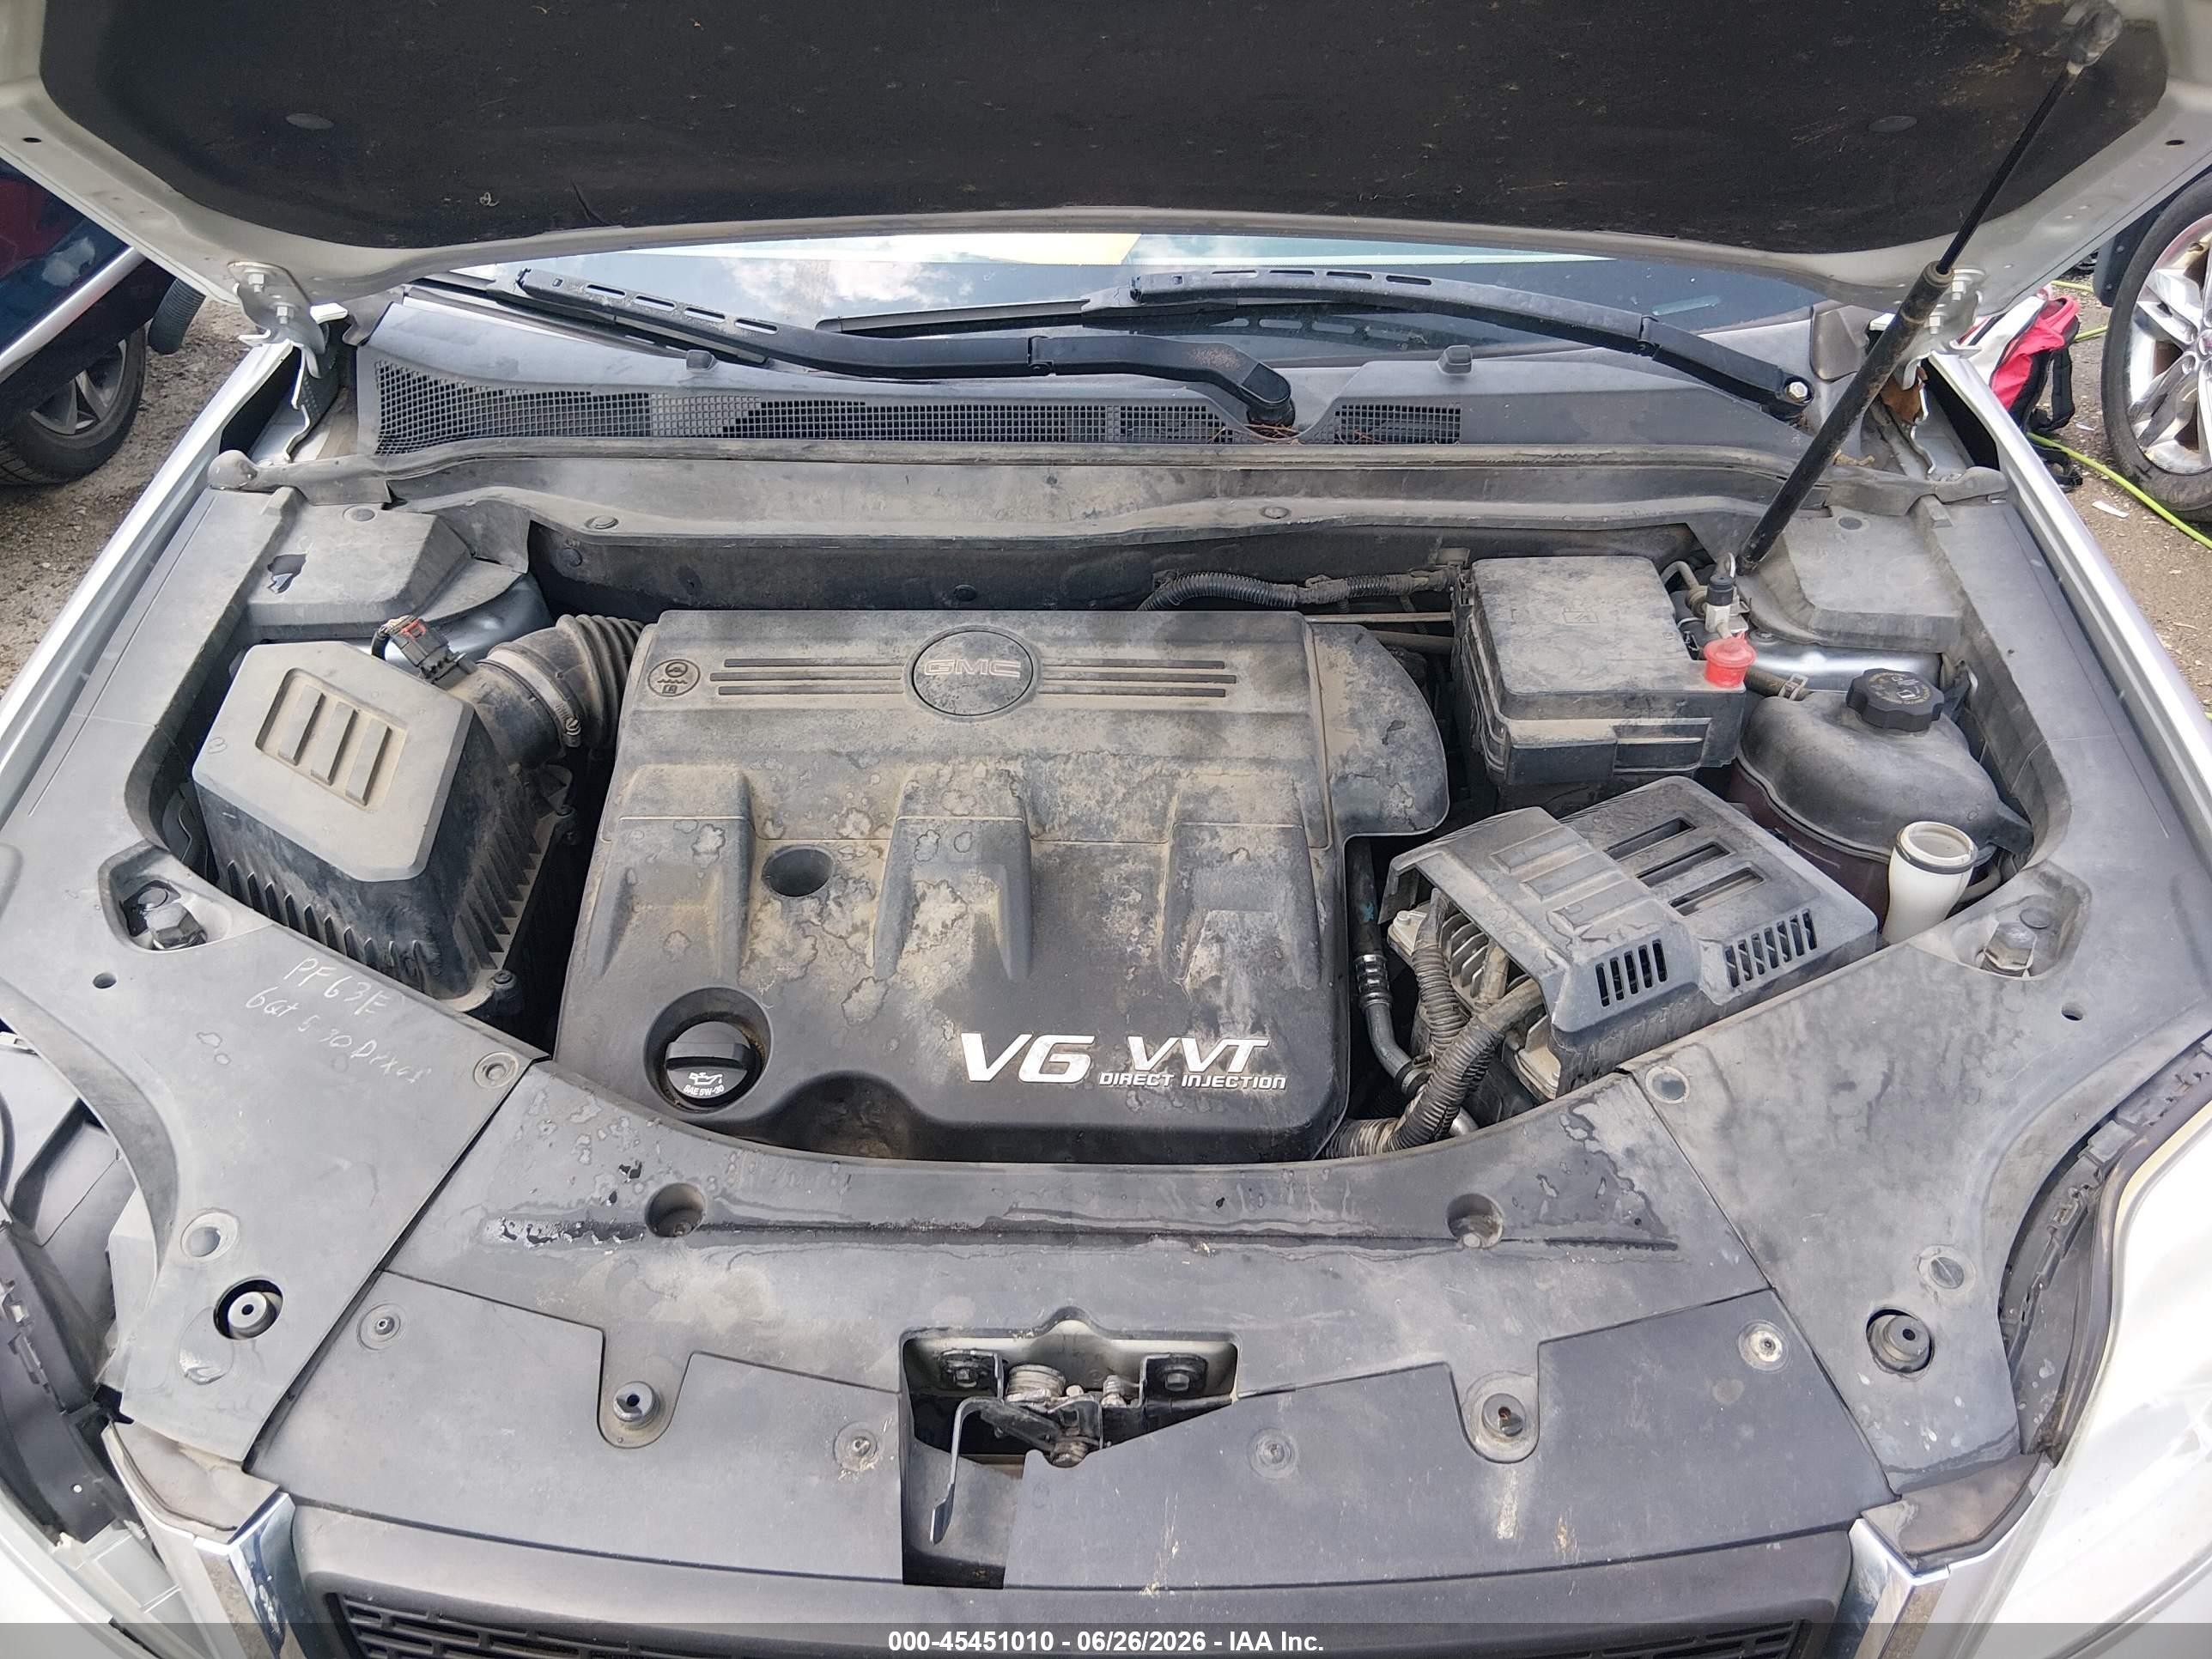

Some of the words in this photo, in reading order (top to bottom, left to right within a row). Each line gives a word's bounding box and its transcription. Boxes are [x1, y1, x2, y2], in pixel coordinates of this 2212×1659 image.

[924, 659, 1021, 678] GMC
[960, 1032, 1096, 1084] V6
[1127, 1036, 1271, 1073] VVT
[684, 1085, 699, 1095] SAE
[699, 1085, 724, 1096] 5W-30
[1099, 1073, 1175, 1088] DIRECT
[1181, 1074, 1286, 1090] INJECTION
